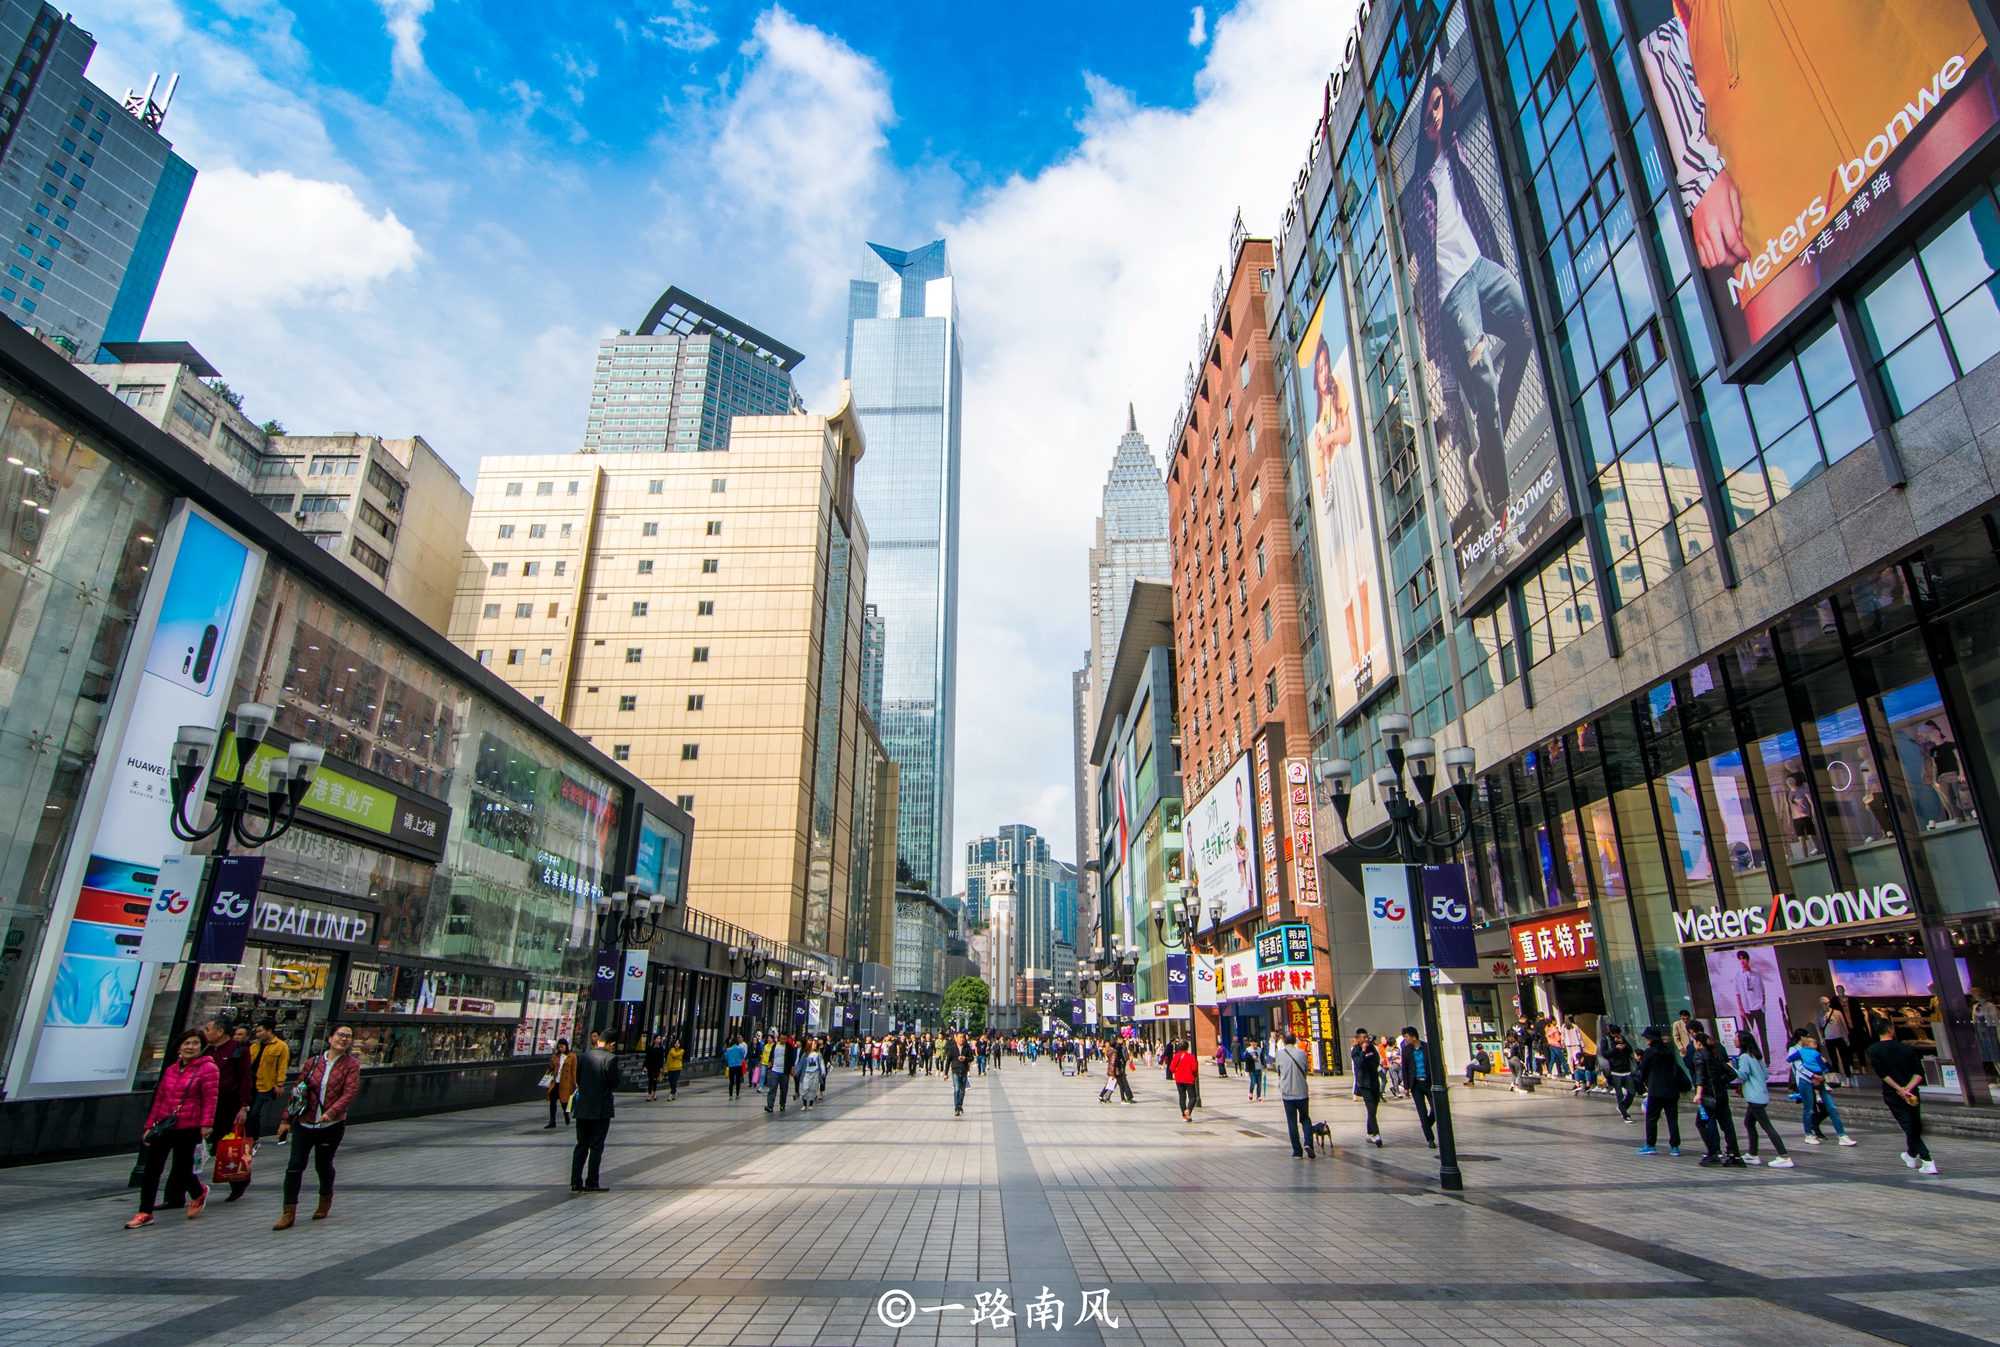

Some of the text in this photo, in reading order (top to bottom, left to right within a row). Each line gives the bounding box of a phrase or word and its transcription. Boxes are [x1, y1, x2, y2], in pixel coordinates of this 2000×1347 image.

[1727, 55, 1967, 305] Meters/bonwe
[1798, 171, 1891, 266] 不走寻常路
[1461, 469, 1554, 569] Meters/bonwe
[127, 757, 166, 776] HUAWEI
[131, 780, 167, 796] 未来影
[403, 812, 436, 838] 请上2楼
[1256, 735, 1279, 897] 西南眼镜城
[156, 890, 189, 914] 5G
[213, 891, 249, 918] 5G
[1373, 897, 1406, 921] 5G
[1431, 896, 1467, 923] 5G
[1673, 882, 1911, 944] Meters/bonwe
[1289, 940, 1307, 949] 酒店
[1518, 920, 1594, 962] 重庆特产
[1294, 951, 1305, 960] 5F
[597, 966, 615, 980] 5G
[627, 966, 644, 978] 5G
[1169, 969, 1186, 983] 5G
[1198, 969, 1213, 982] 5G
[1289, 970, 1313, 991] 特产
[732, 993, 743, 1002] 5G
[750, 993, 763, 1003] 5G
[1104, 993, 1115, 1001] 5G
[1122, 992, 1134, 1002] 5G
[1291, 1000, 1305, 1036] 重庆特
